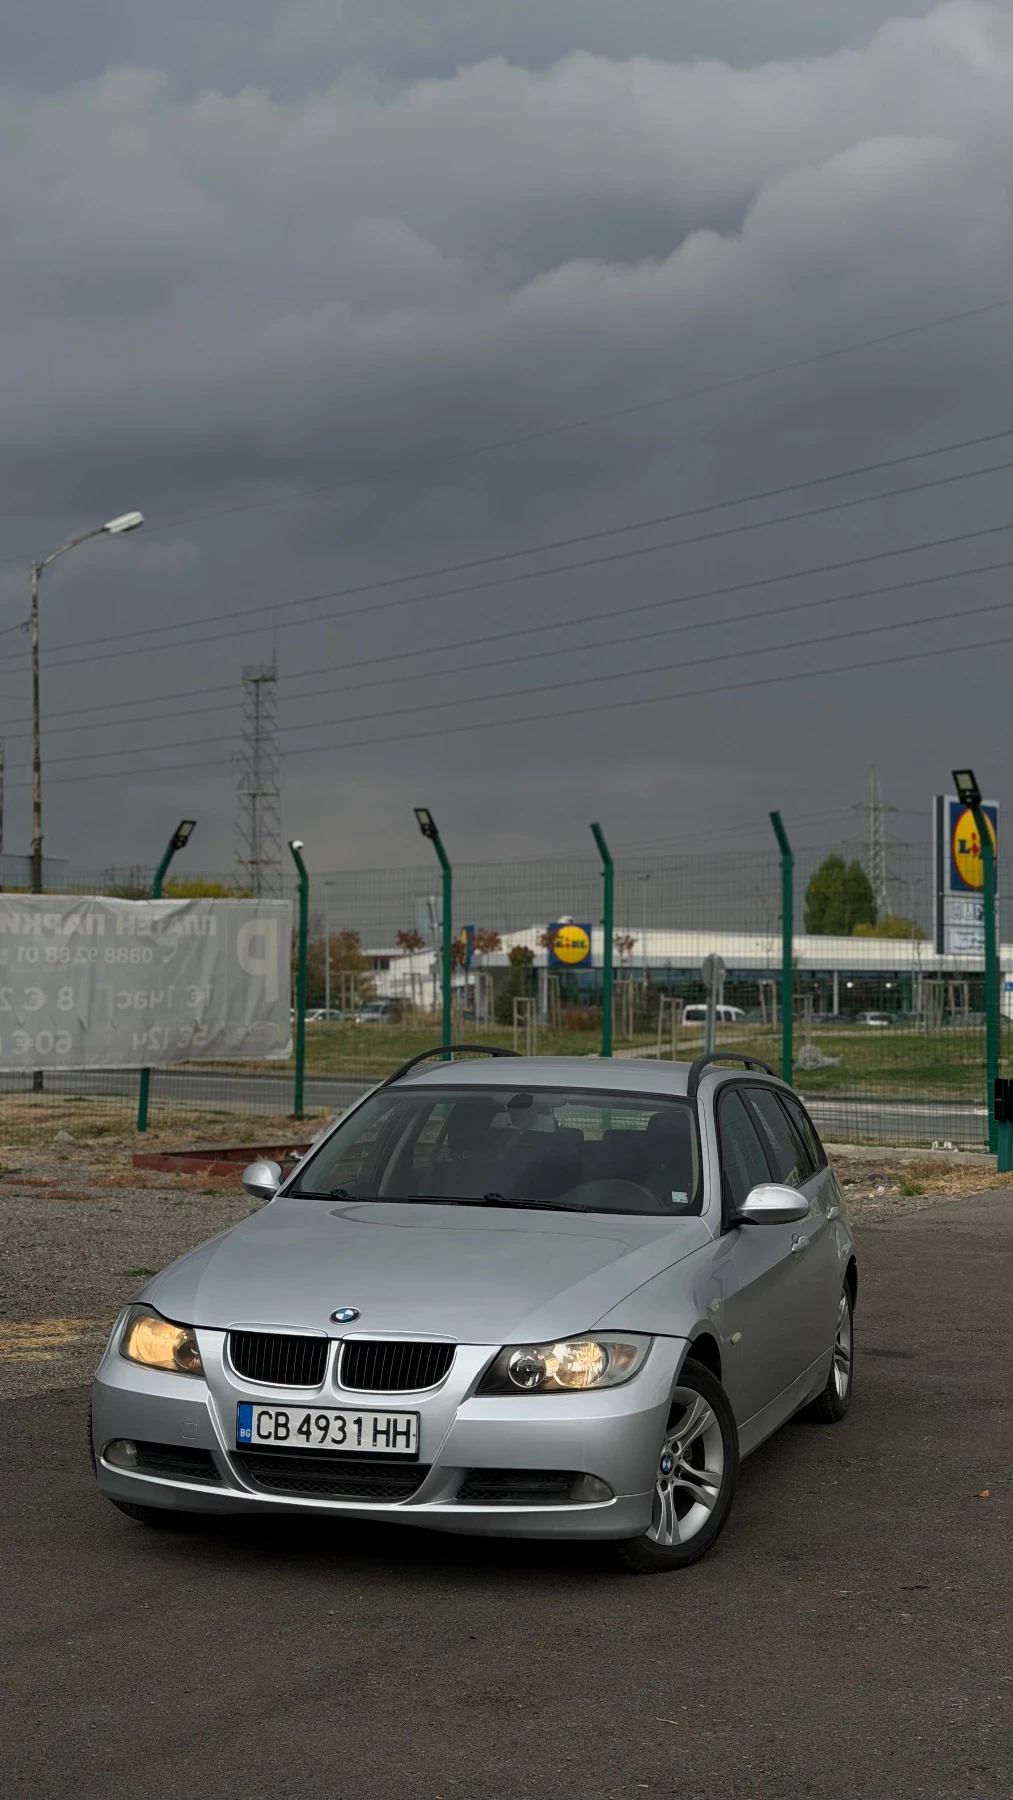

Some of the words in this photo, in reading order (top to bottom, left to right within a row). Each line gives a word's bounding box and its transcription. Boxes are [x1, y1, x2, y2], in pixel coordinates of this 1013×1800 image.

[240, 1428, 251, 1438] BG
[256, 1410, 290, 1441] CB
[296, 1413, 363, 1446] 4931
[372, 1416, 412, 1449] HH
